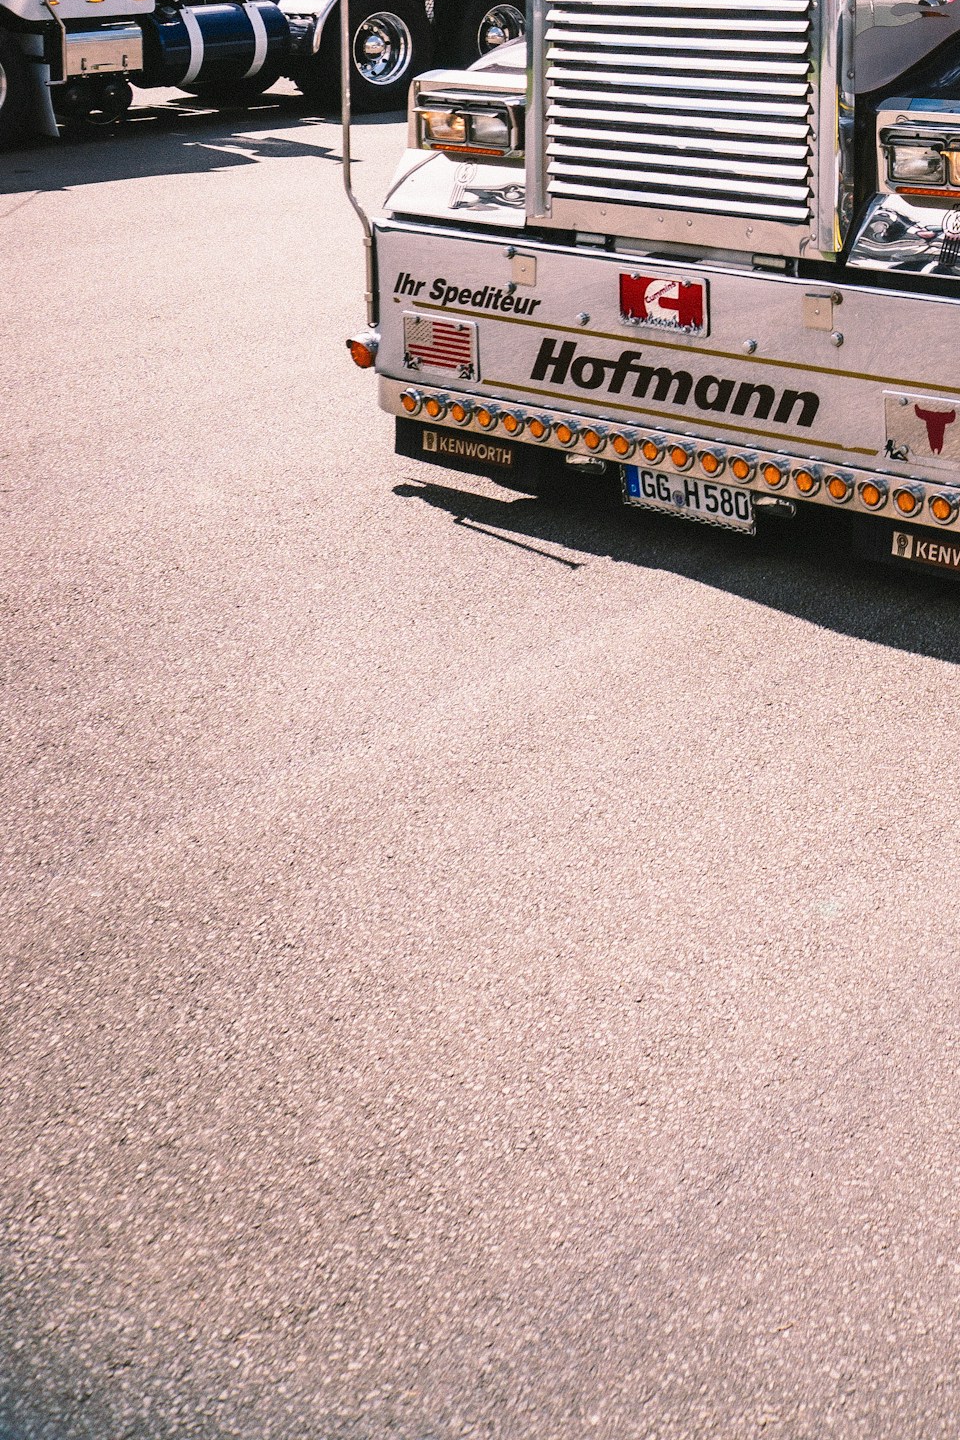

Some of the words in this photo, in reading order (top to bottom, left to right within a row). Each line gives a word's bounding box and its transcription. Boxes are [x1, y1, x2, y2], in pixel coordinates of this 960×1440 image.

[393, 272, 426, 296] Ihr
[644, 281, 677, 304] Cummins
[530, 337, 820, 428] Hofmann
[440, 436, 512, 464] KENWORTH
[641, 470, 672, 502] GG
[683, 479, 700, 509] H
[703, 484, 750, 520] 580
